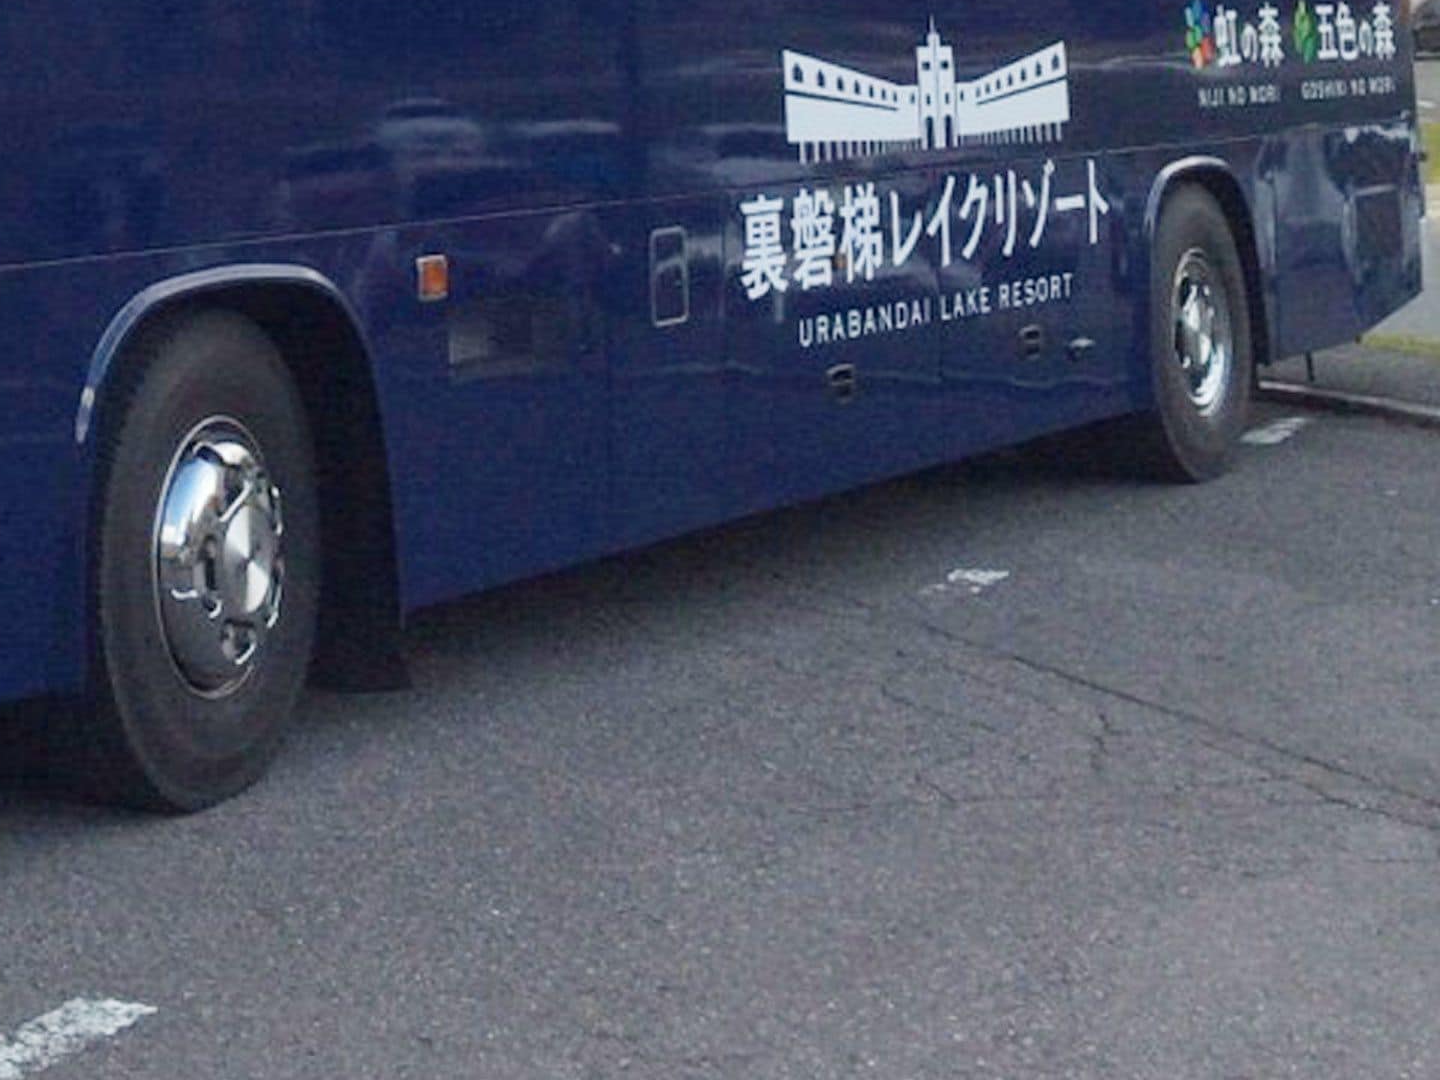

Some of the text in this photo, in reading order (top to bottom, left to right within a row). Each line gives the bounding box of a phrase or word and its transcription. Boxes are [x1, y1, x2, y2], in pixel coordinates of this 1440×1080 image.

[1213, 1, 1285, 69] 虹の森
[1314, 0, 1397, 62] 五色の森
[739, 158, 1110, 301] 裏磐梯レイクリゾート
[798, 272, 1074, 348] URABANDAI LAKE RESORT
